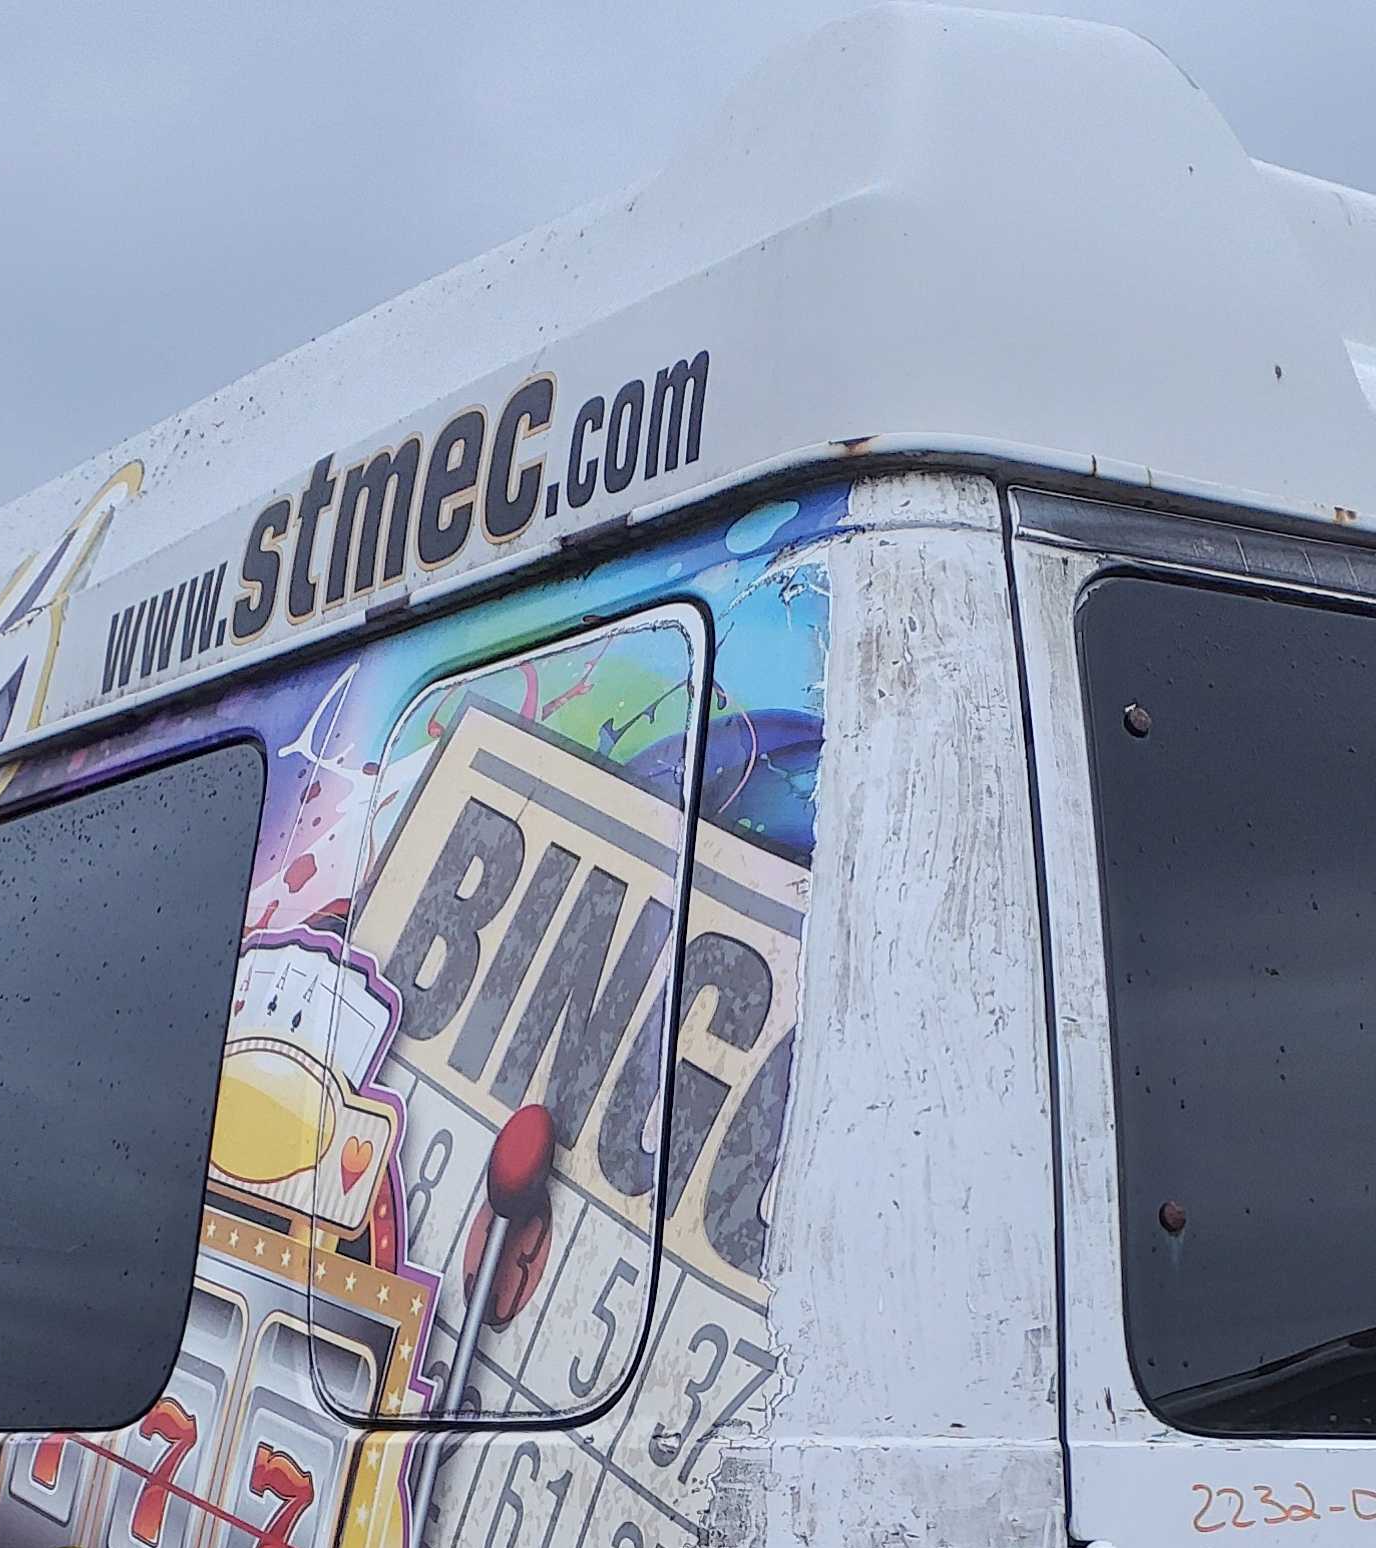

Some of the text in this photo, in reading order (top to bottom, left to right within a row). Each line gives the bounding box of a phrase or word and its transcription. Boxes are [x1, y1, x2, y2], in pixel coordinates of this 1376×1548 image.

[101, 350, 711, 695] www.stmec.com
[569, 1256, 639, 1398] 5
[132, 1398, 198, 1548] 7
